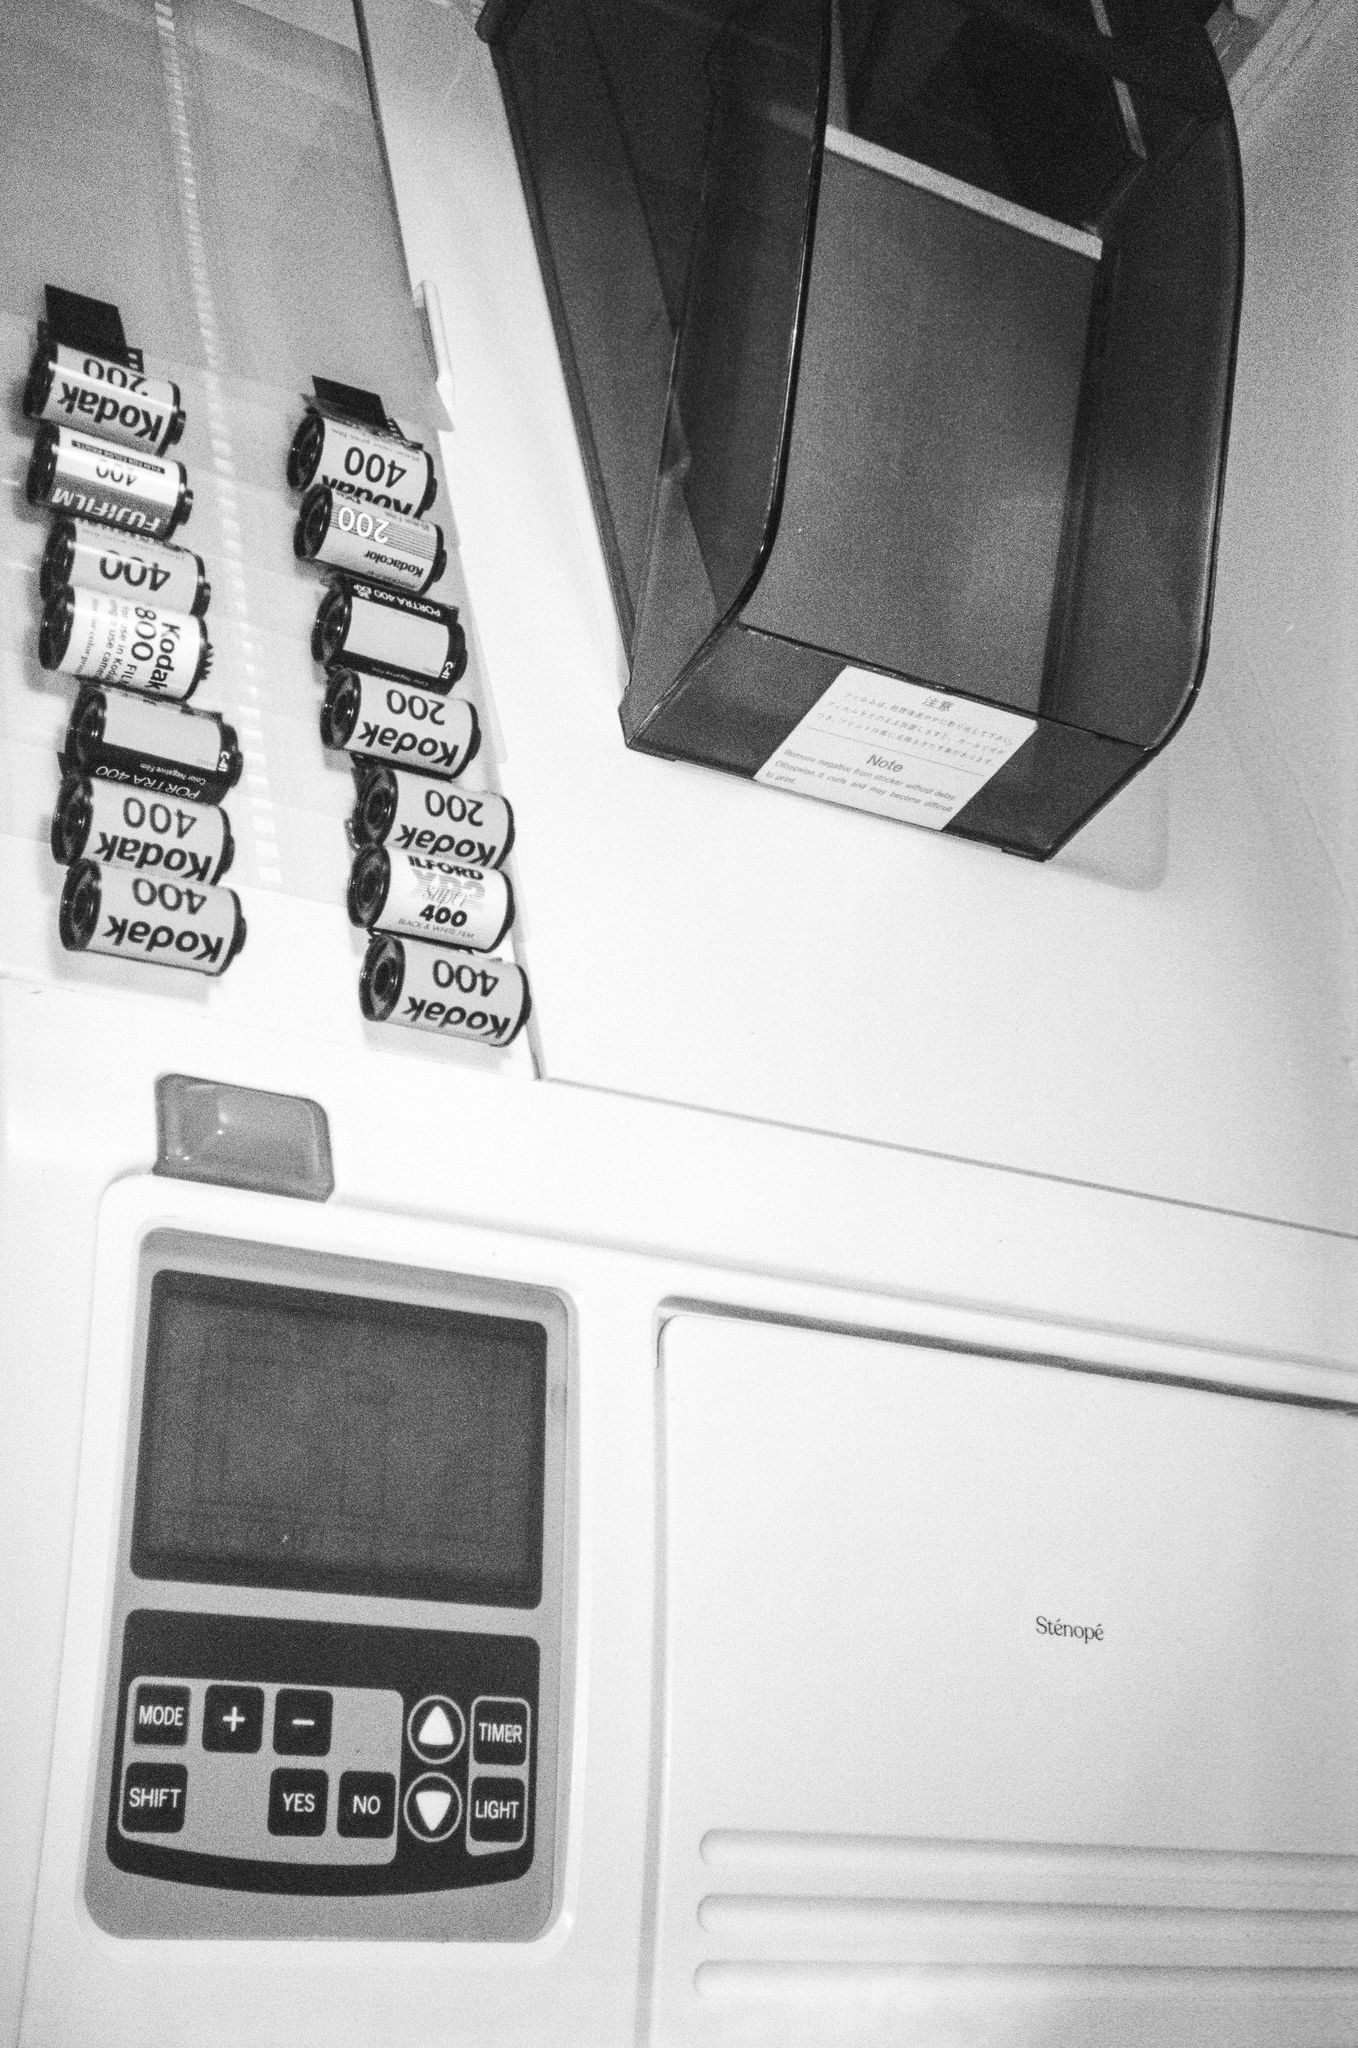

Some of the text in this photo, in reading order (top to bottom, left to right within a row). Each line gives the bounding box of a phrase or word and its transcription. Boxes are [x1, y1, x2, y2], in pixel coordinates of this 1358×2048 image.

[82, 358, 148, 396] 200
[58, 382, 163, 442] Kodak
[344, 446, 407, 488] 400
[52, 488, 160, 532] FUJIFILM
[338, 506, 390, 543] 200
[100, 550, 171, 591] 400
[364, 550, 424, 578] Kodacolor
[373, 589, 441, 617] PORTRA 400
[131, 607, 157, 661] 800
[145, 622, 180, 690] Kodak
[386, 689, 445, 726] 200
[920, 695, 955, 712] 注意
[357, 721, 459, 767] Kodak
[782, 749, 817, 763] Remove
[815, 758, 853, 773] negative
[155, 766, 186, 781] Negative
[187, 774, 206, 786] Color
[864, 754, 906, 773] Note
[95, 766, 200, 799] PORTRA 400
[849, 780, 867, 789] and
[123, 797, 197, 839] 400
[425, 789, 484, 827] 200
[94, 831, 212, 882] Kodak
[395, 824, 497, 867] Kodak
[408, 855, 484, 880] ILFORD
[132, 877, 207, 915] 400
[419, 904, 467, 927] 400
[102, 915, 224, 963] Kodak
[433, 959, 499, 998] 400
[402, 996, 511, 1039] Kodak
[1035, 1615, 1104, 1645] Sténopé
[139, 1705, 184, 1727] MODE
[479, 1722, 522, 1744] TIMER
[129, 1787, 182, 1809] SHIFT
[282, 1793, 316, 1813] YES
[352, 1795, 381, 1815] NO
[475, 1799, 520, 1821] LIGHT
